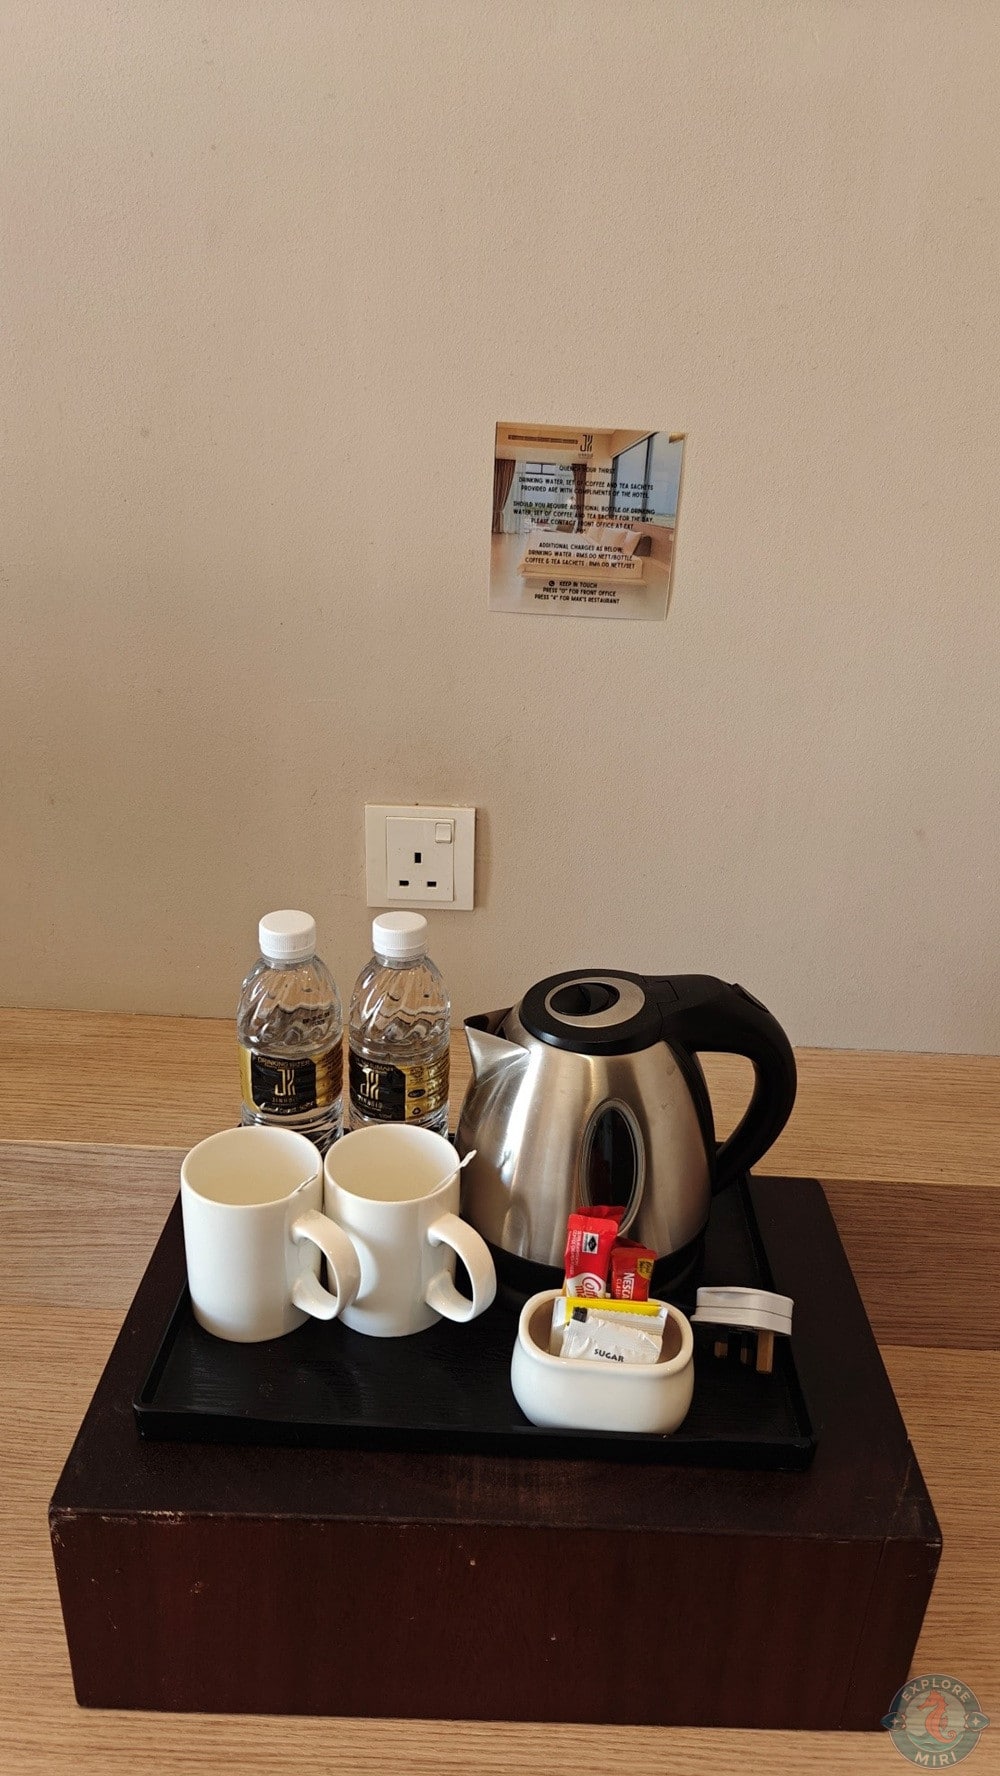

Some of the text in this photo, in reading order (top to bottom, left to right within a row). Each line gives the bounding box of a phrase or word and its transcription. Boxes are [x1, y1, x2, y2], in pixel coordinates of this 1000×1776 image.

[518, 476, 543, 484] DRINKING
[545, 478, 565, 486] WATER,
[630, 483, 654, 491] SACHETS
[520, 485, 547, 493] PROVIDED
[574, 488, 611, 496] COMPLIMENTS
[539, 542, 569, 550] ADDITIONAL
[570, 543, 595, 551] CHARGES
[525, 556, 545, 564] COFFEE
[562, 559, 585, 567] SACHETS
[611, 562, 635, 570] NETT/SET
[598, 553, 633, 562] NETT/BOTTLE
[587, 597, 620, 605] RESTAURANT
[594, 1348, 625, 1363] SUGAR
